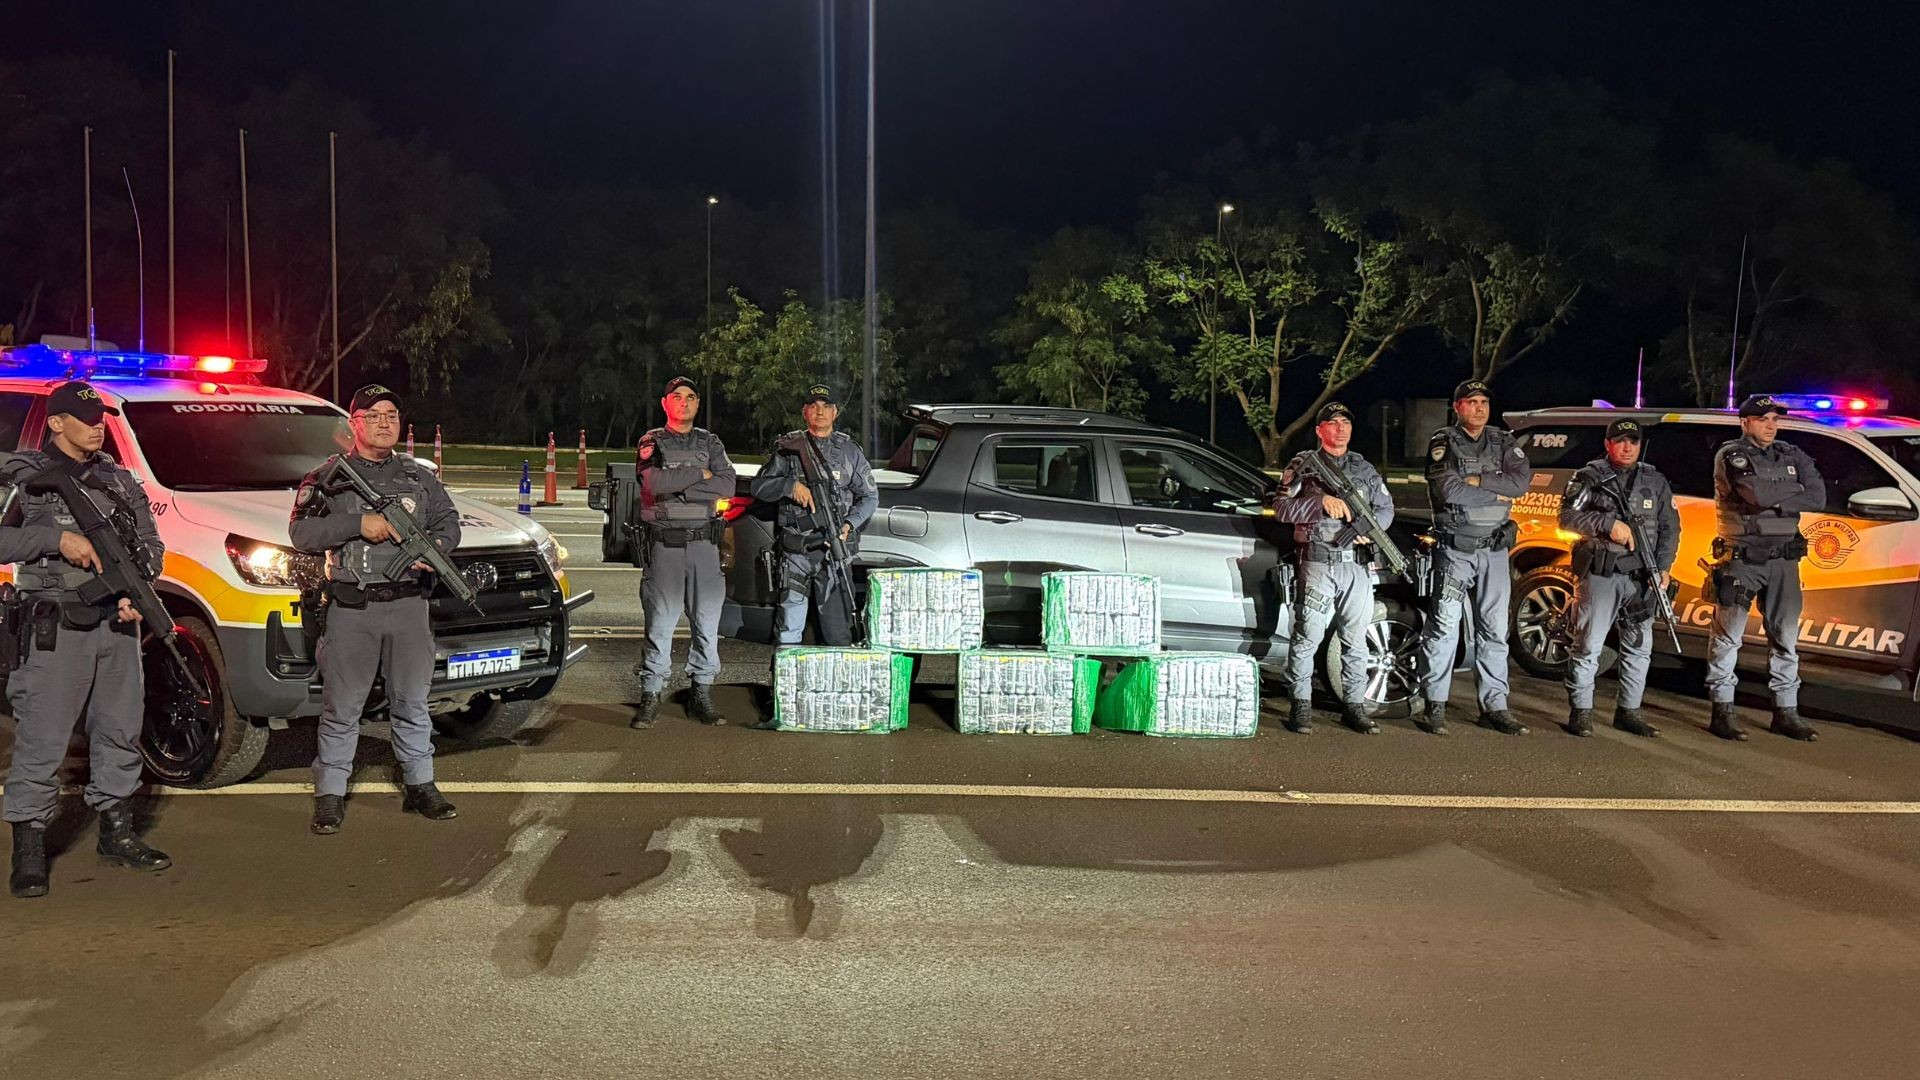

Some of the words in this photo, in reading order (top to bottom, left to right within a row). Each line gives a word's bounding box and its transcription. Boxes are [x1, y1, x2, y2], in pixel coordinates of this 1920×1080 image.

[77, 388, 101, 400] TO
[172, 402, 304, 415] RODOVIÁRIA
[1533, 434, 1568, 448] TOR
[149, 501, 168, 516] 90
[1511, 504, 1558, 517] ODOVIÁRIA
[1834, 522, 1857, 542] MILITAR
[1758, 618, 1905, 654] LITAR
